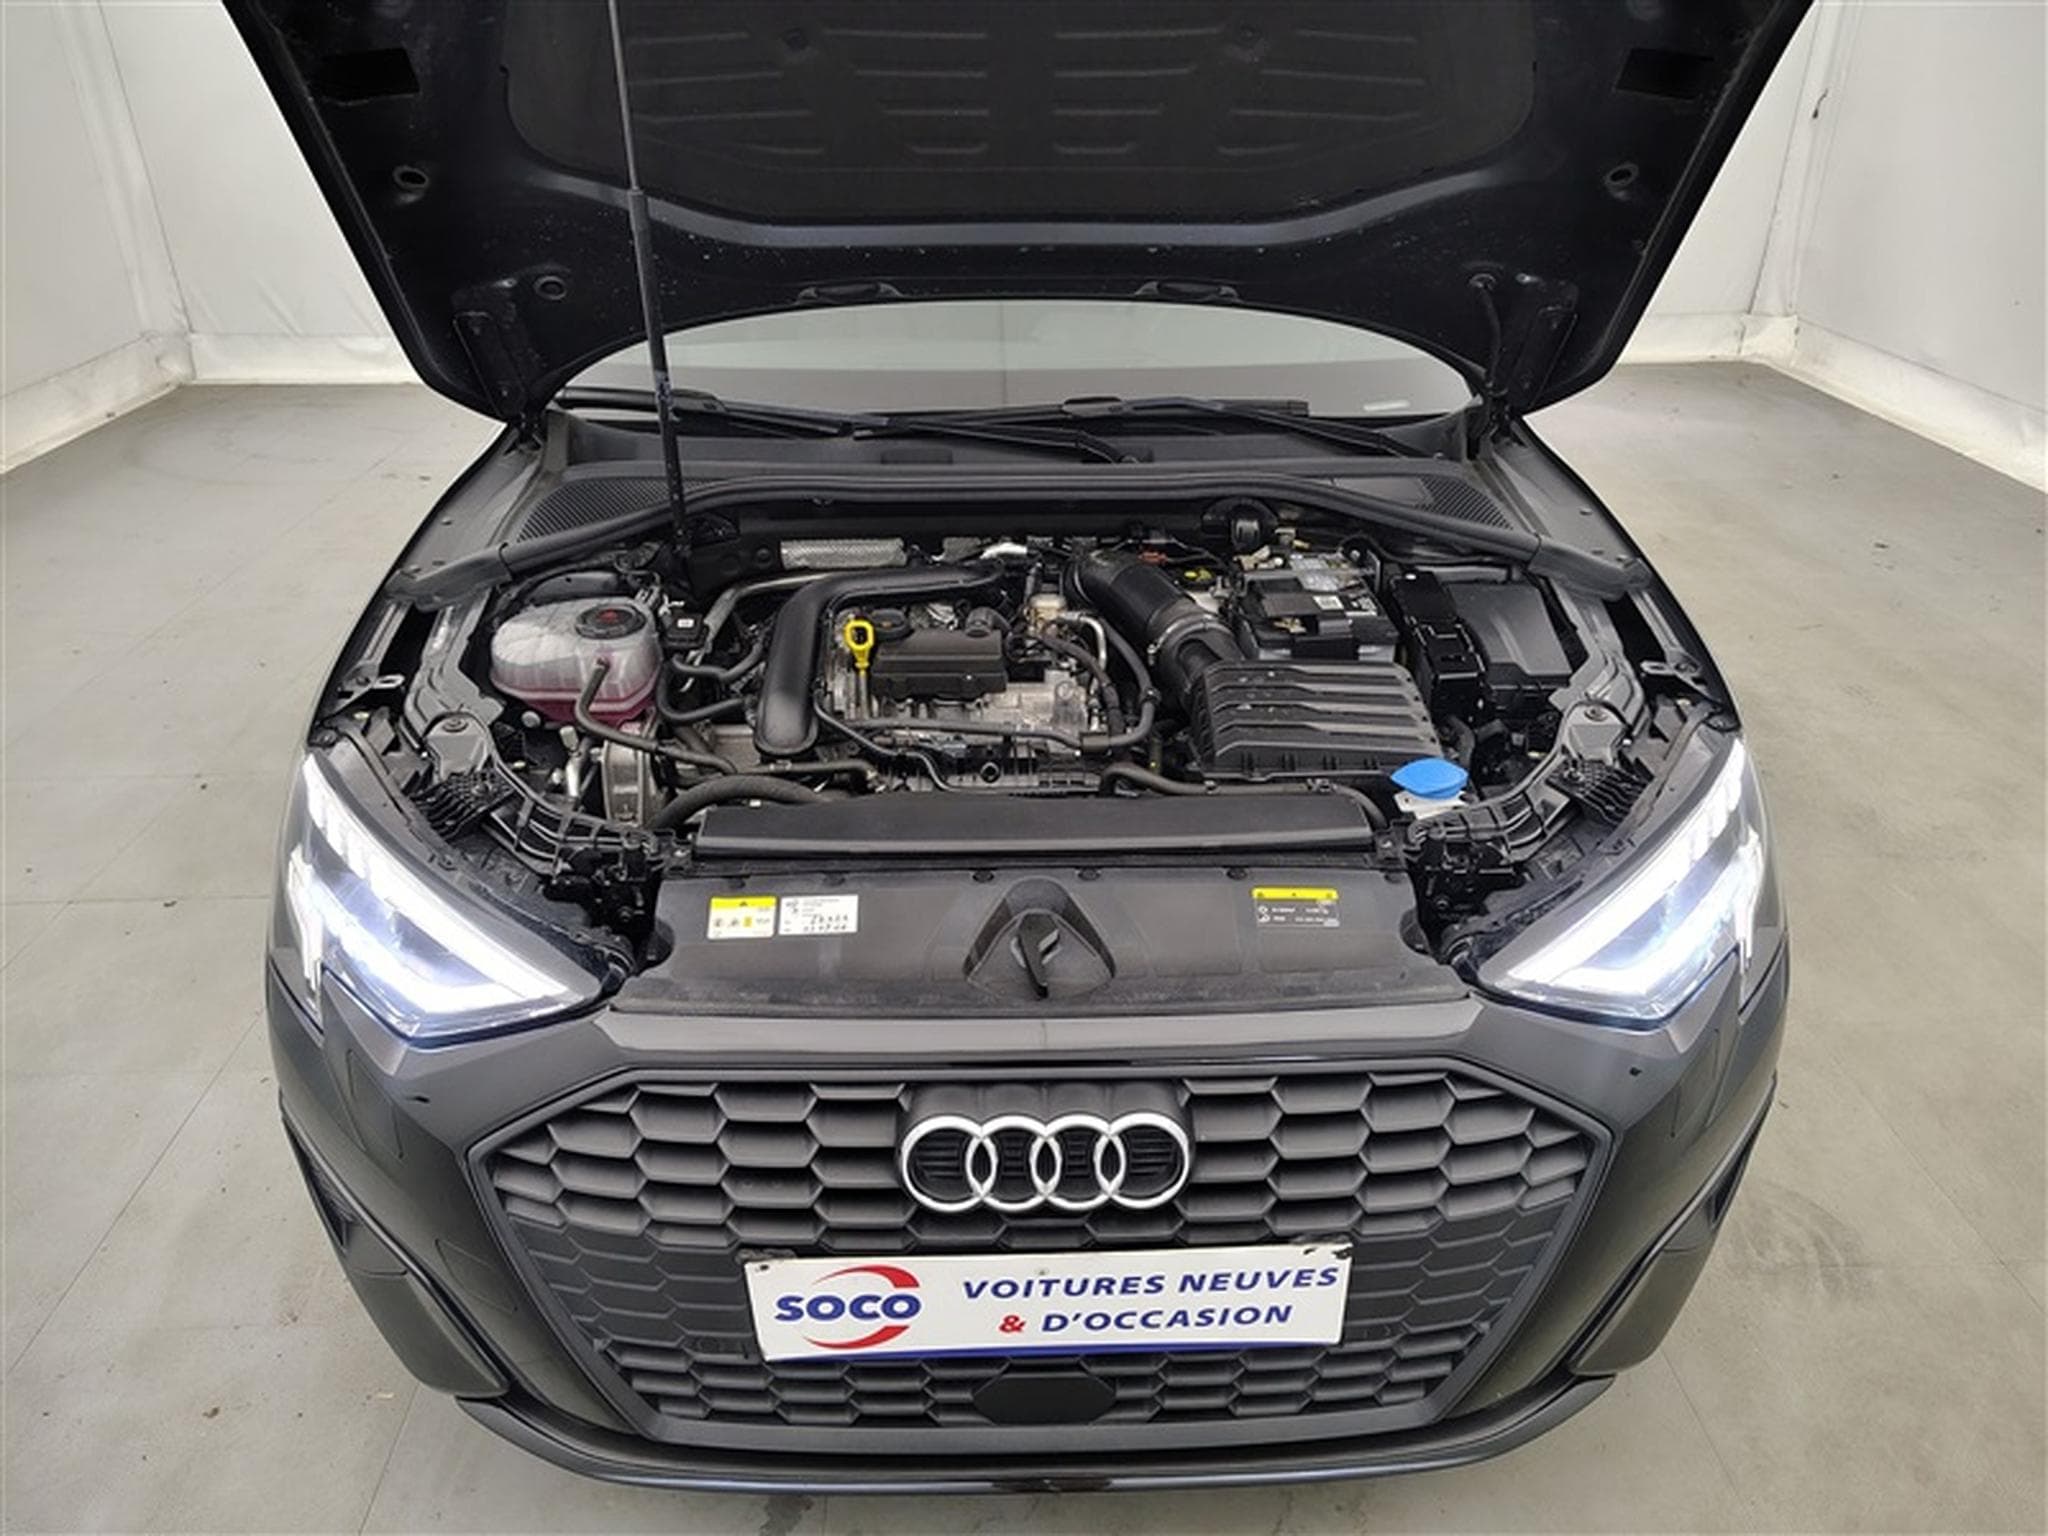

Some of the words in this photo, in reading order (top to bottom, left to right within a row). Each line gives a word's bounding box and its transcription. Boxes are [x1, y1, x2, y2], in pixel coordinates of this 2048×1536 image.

[964, 1275, 1165, 1299] VOITURES
[1178, 1268, 1338, 1293] NEUVES
[775, 1294, 921, 1322] SOCO
[999, 1315, 1025, 1334] &
[1042, 1306, 1291, 1332] D'OCCASION
